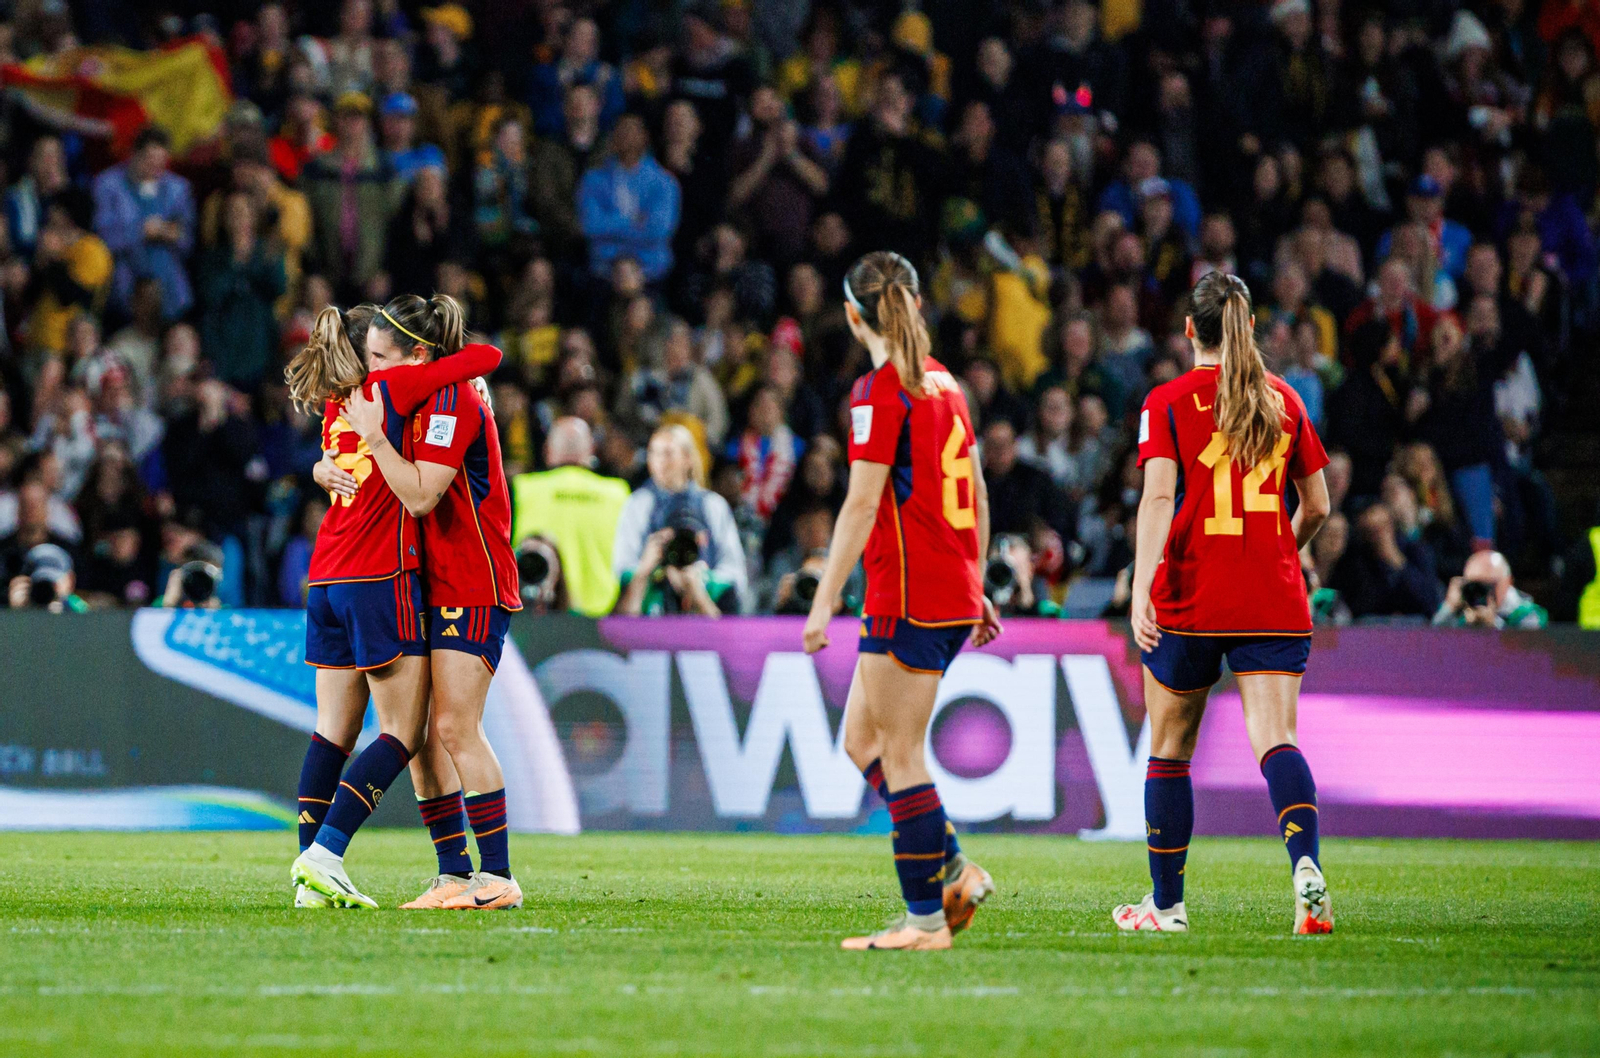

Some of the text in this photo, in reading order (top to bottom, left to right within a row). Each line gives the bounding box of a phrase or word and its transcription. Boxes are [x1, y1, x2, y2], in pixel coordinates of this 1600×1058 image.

[1193, 393, 1212, 412] L.
[320, 415, 373, 508] 9
[941, 414, 976, 530] 6
[1197, 431, 1292, 536] 14
